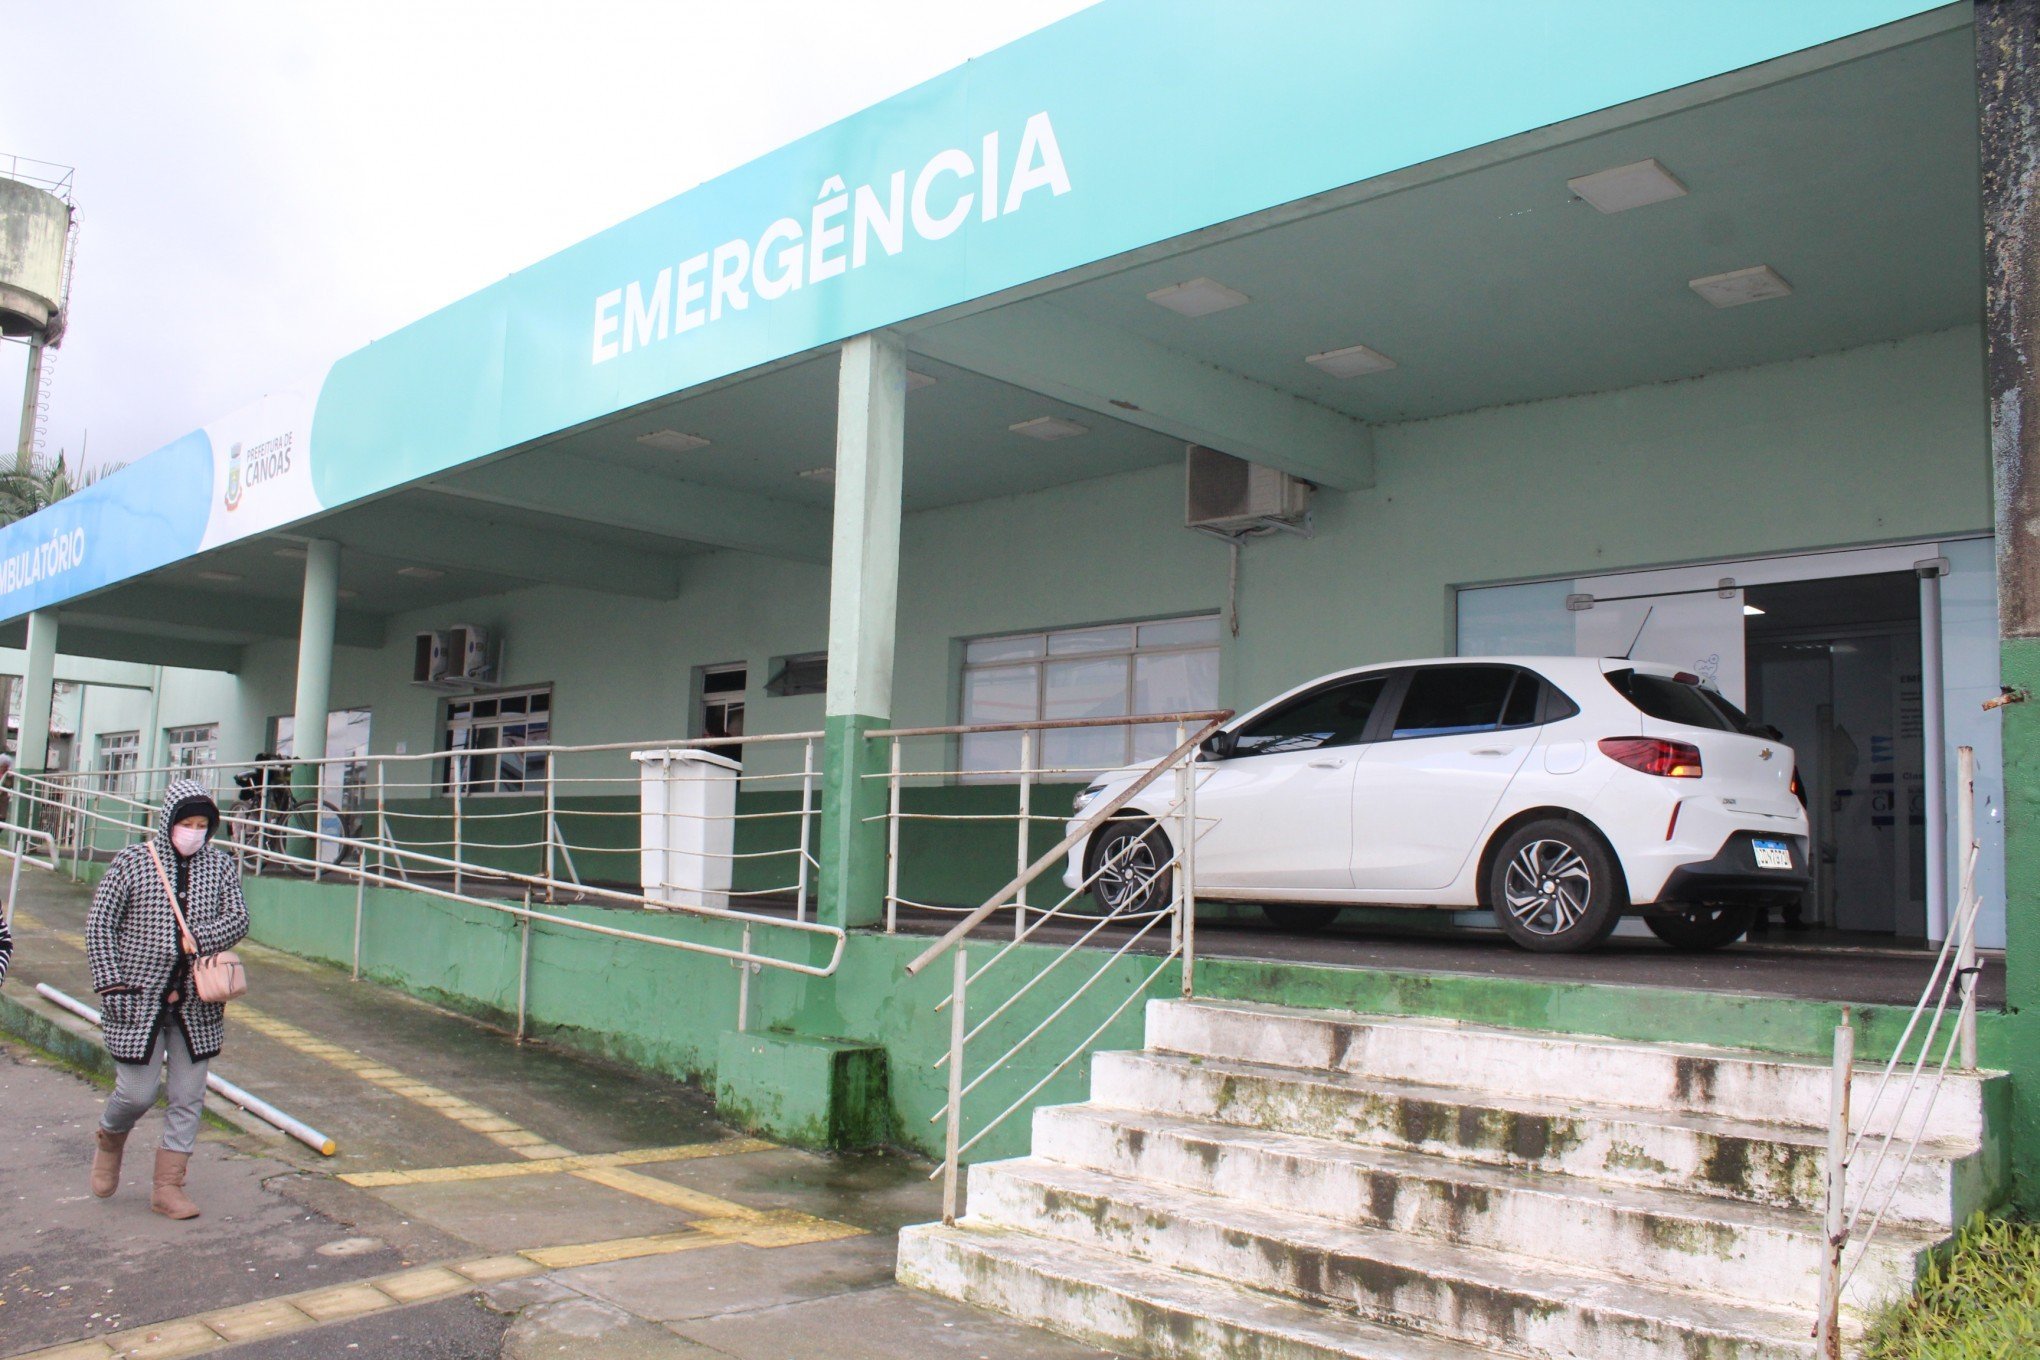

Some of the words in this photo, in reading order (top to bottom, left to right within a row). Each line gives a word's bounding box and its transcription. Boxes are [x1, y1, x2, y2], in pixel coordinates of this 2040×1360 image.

[592, 110, 1072, 366] EMERGÊNCIA
[246, 436, 283, 462] PREFEITURA
[284, 431, 293, 447] DE
[246, 446, 292, 488] CANOAS
